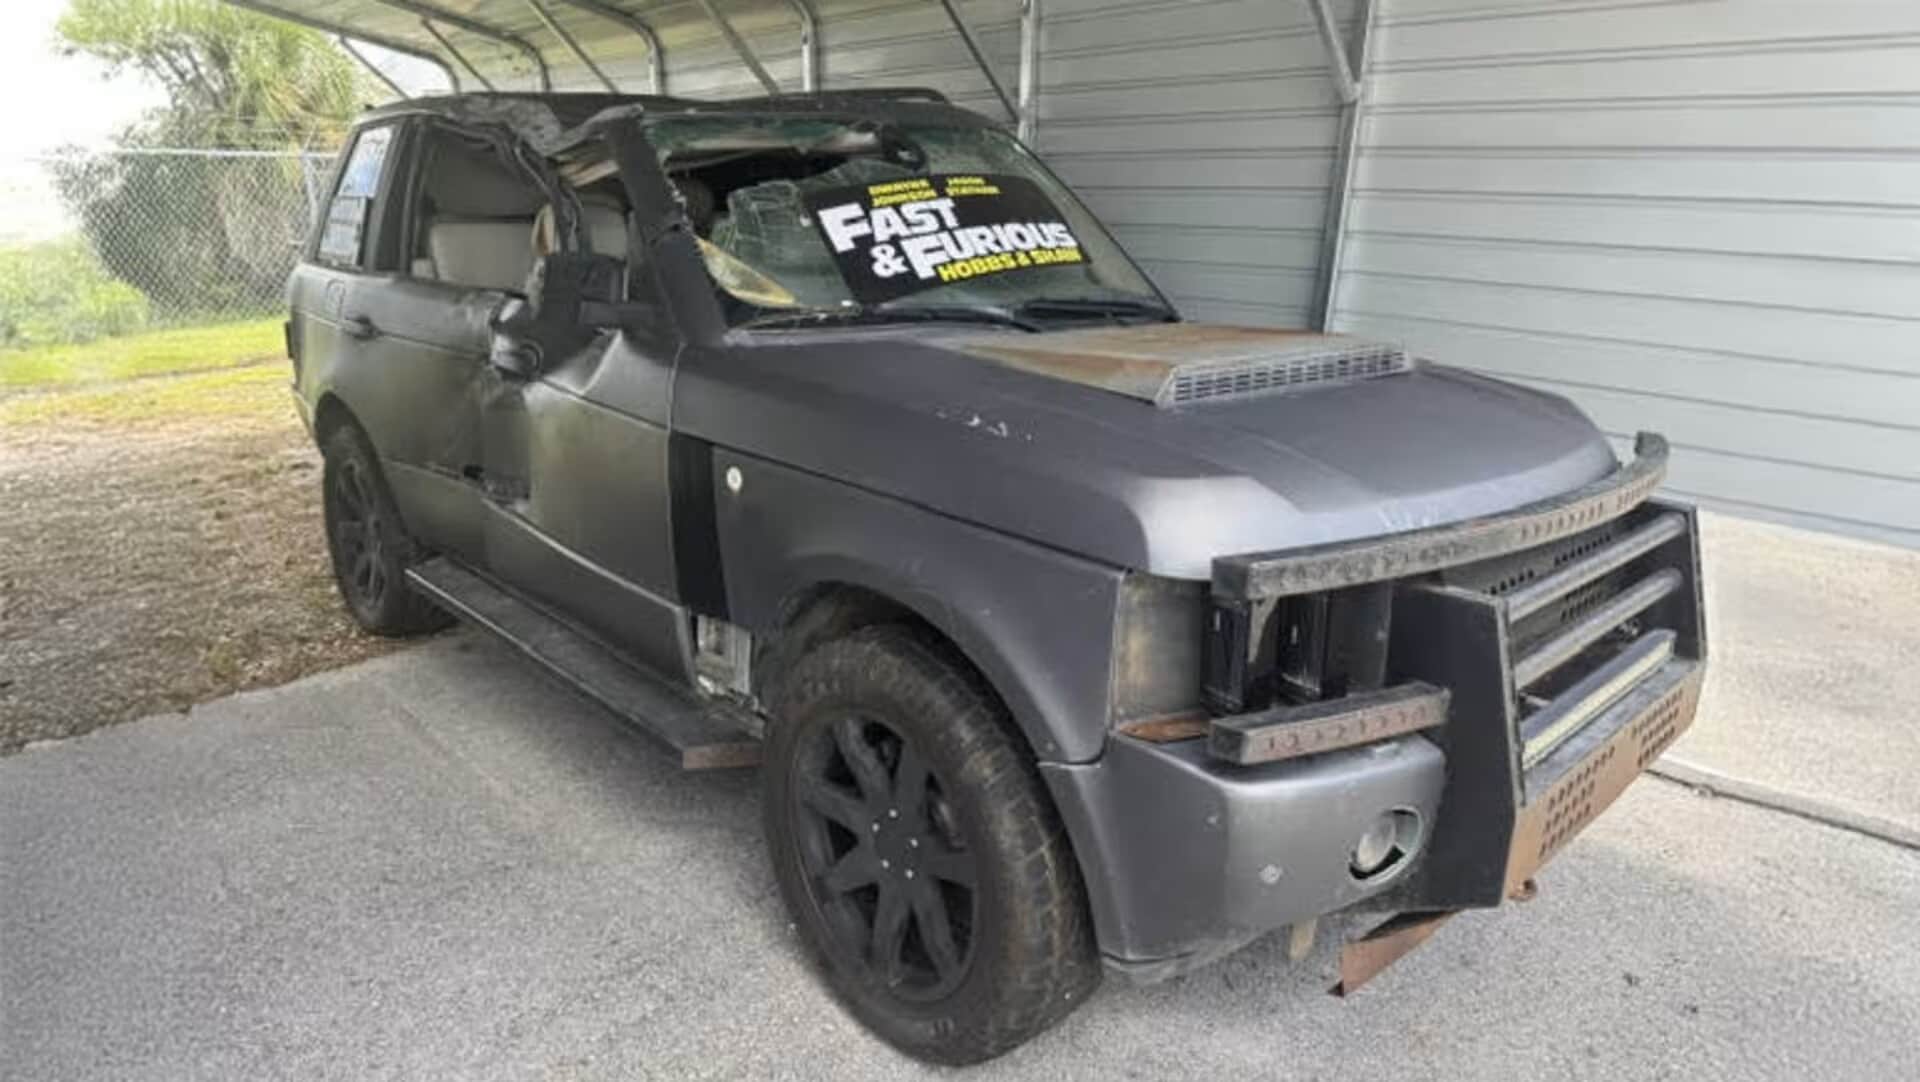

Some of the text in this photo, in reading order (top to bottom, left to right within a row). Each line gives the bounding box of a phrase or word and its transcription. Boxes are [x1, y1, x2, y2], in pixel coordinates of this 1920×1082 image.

[818, 197, 959, 253] FAST
[870, 222, 1078, 280] & FURIOUS
[938, 252, 1017, 281] HOBBS
